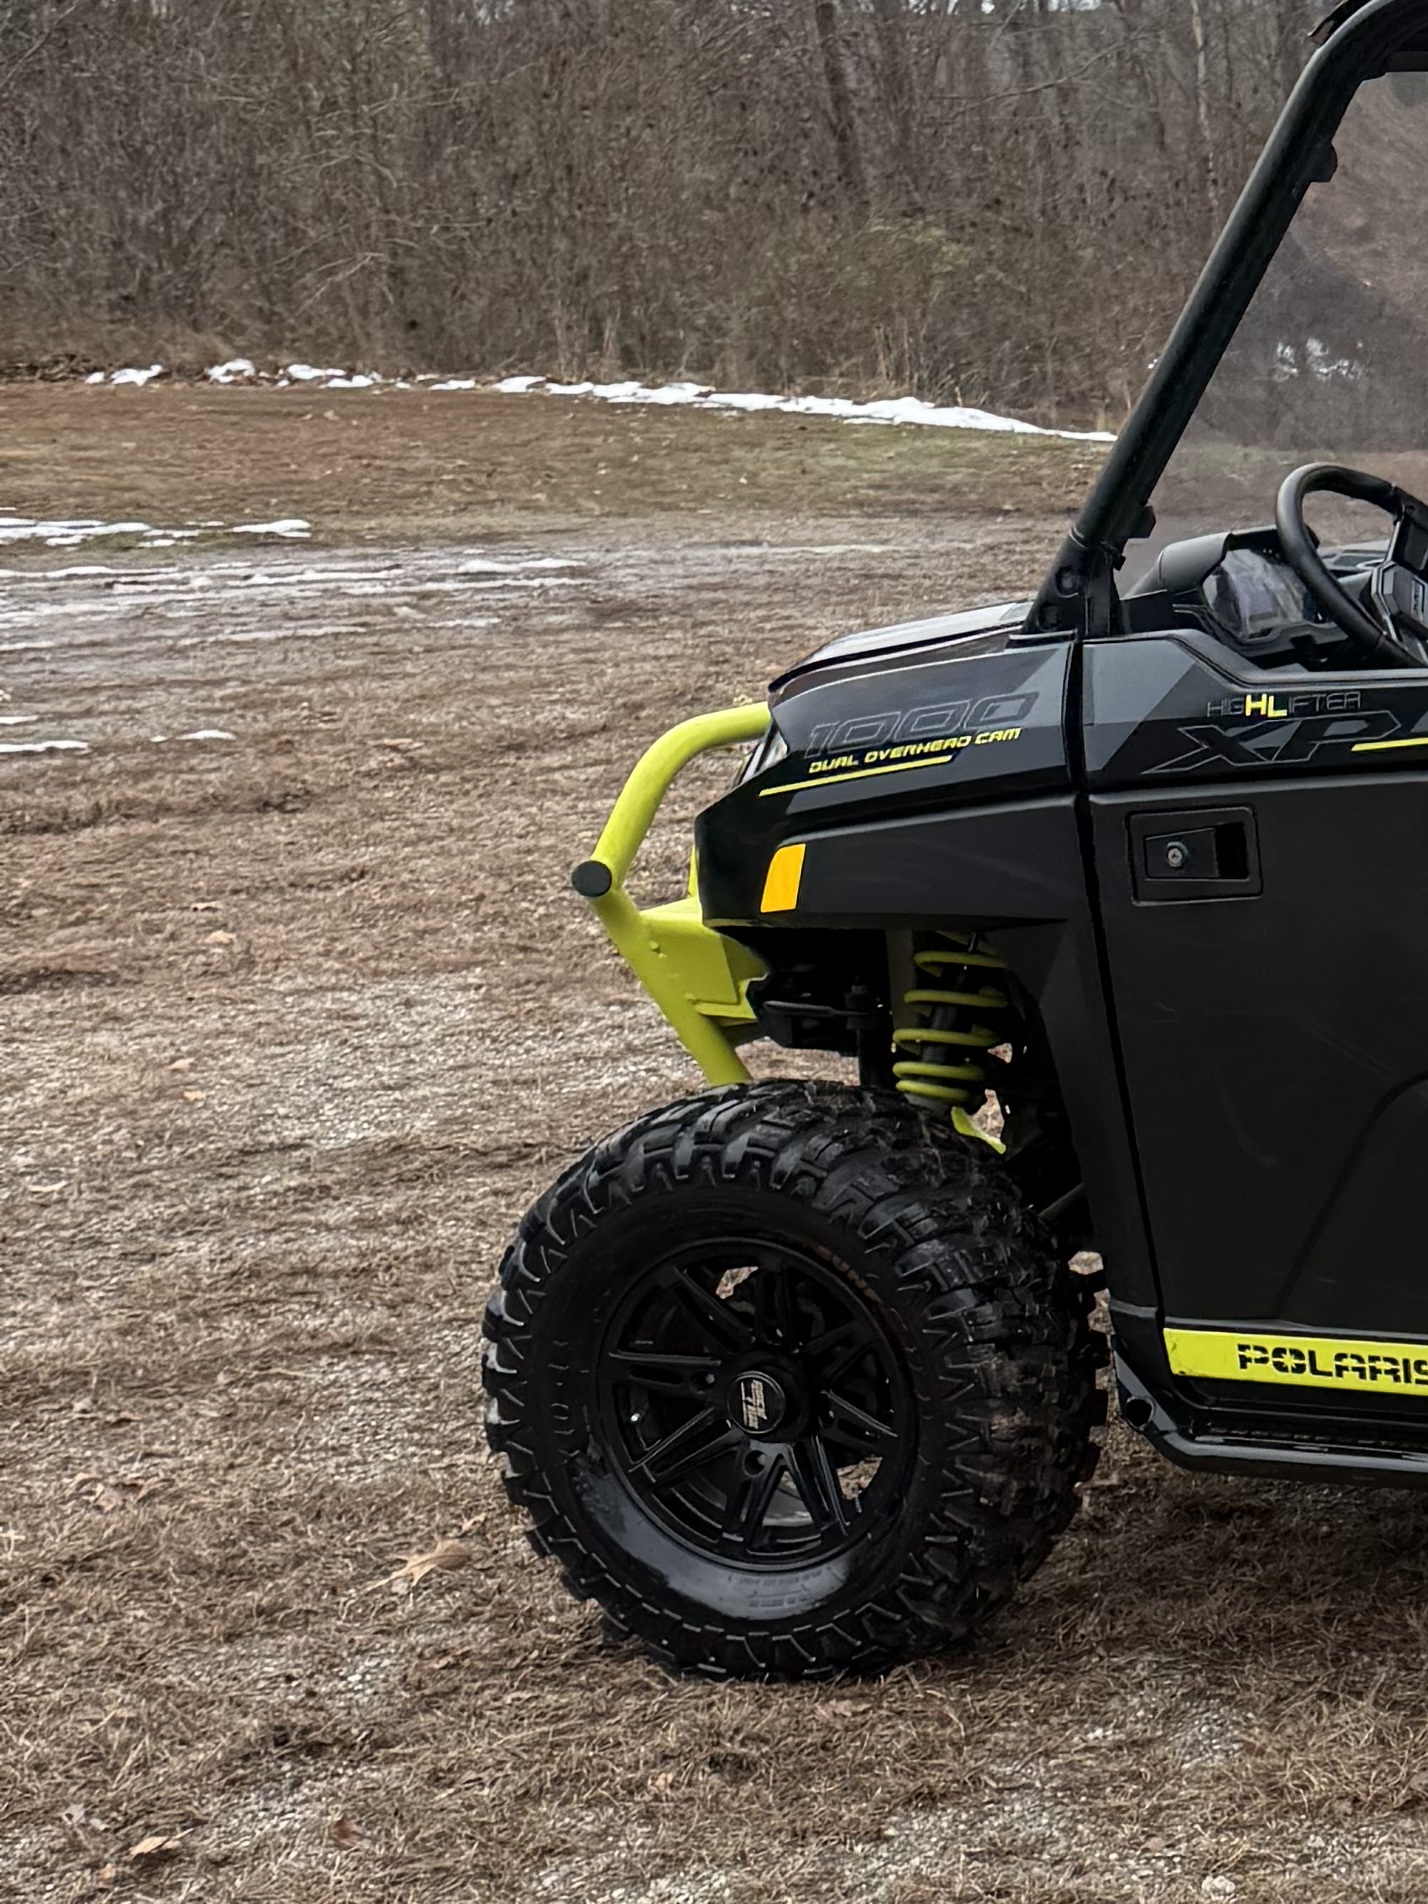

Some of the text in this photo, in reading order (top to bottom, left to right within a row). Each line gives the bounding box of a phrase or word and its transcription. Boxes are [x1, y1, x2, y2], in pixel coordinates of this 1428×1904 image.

[804, 691, 1040, 759] 1000
[808, 727, 1022, 774] DUAL OVERHEAD CAM
[1140, 710, 1401, 775] XP
